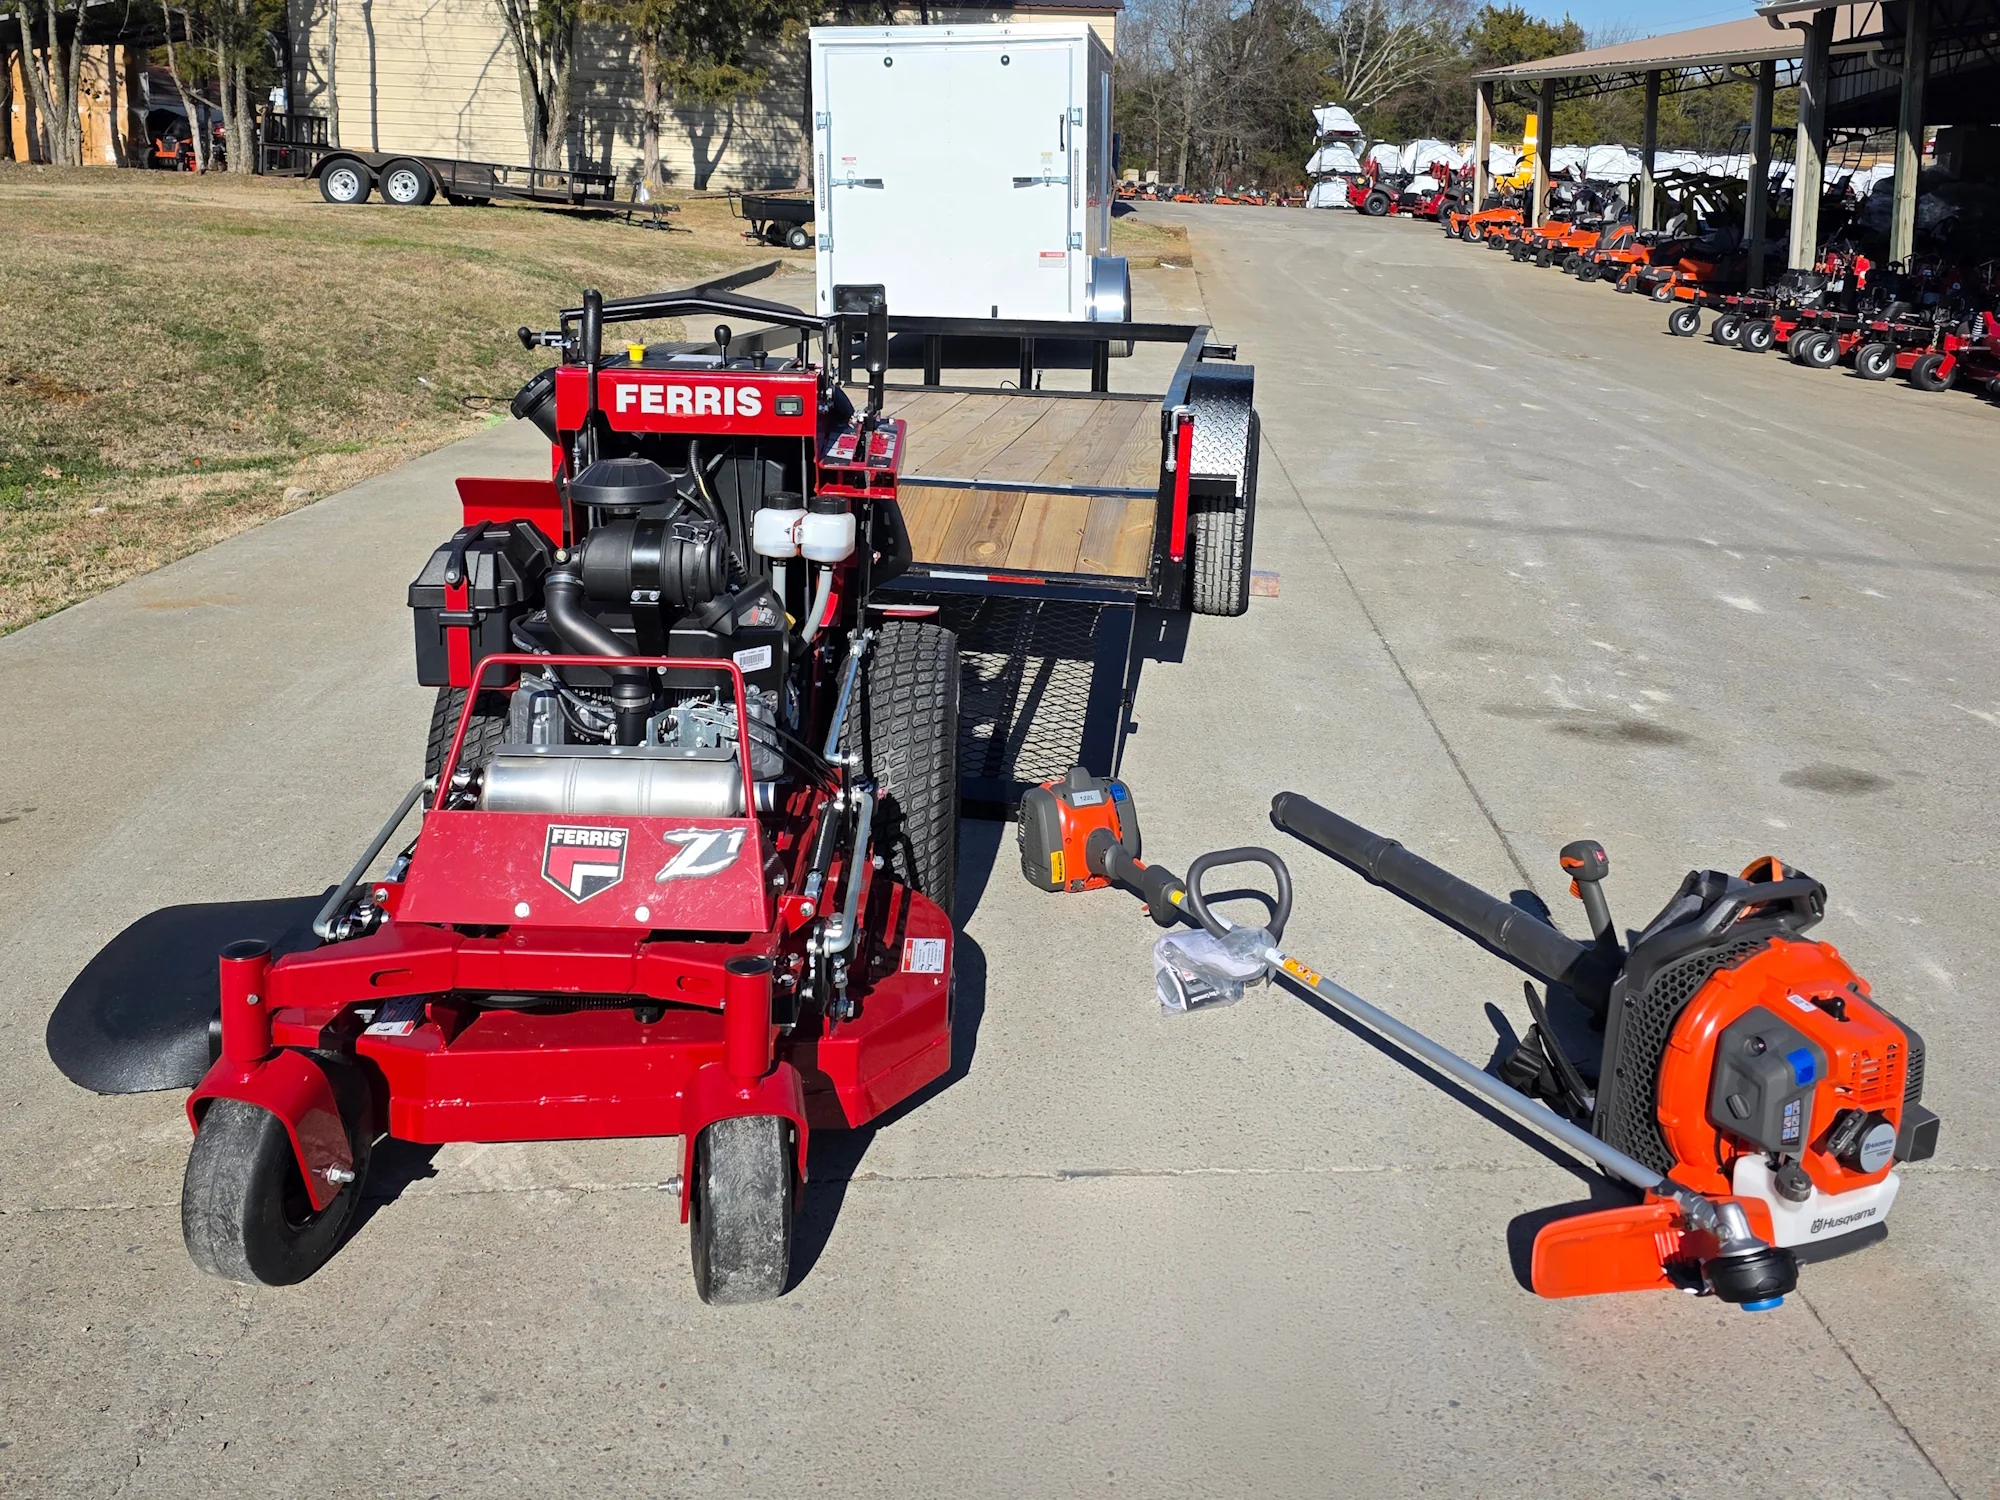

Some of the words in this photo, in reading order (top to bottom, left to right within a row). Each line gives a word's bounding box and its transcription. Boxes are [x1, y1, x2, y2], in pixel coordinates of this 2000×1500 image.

[615, 384, 762, 417] FERRIS
[551, 829, 625, 847] FERRIS
[1823, 1207, 1876, 1230] Husqvarna
